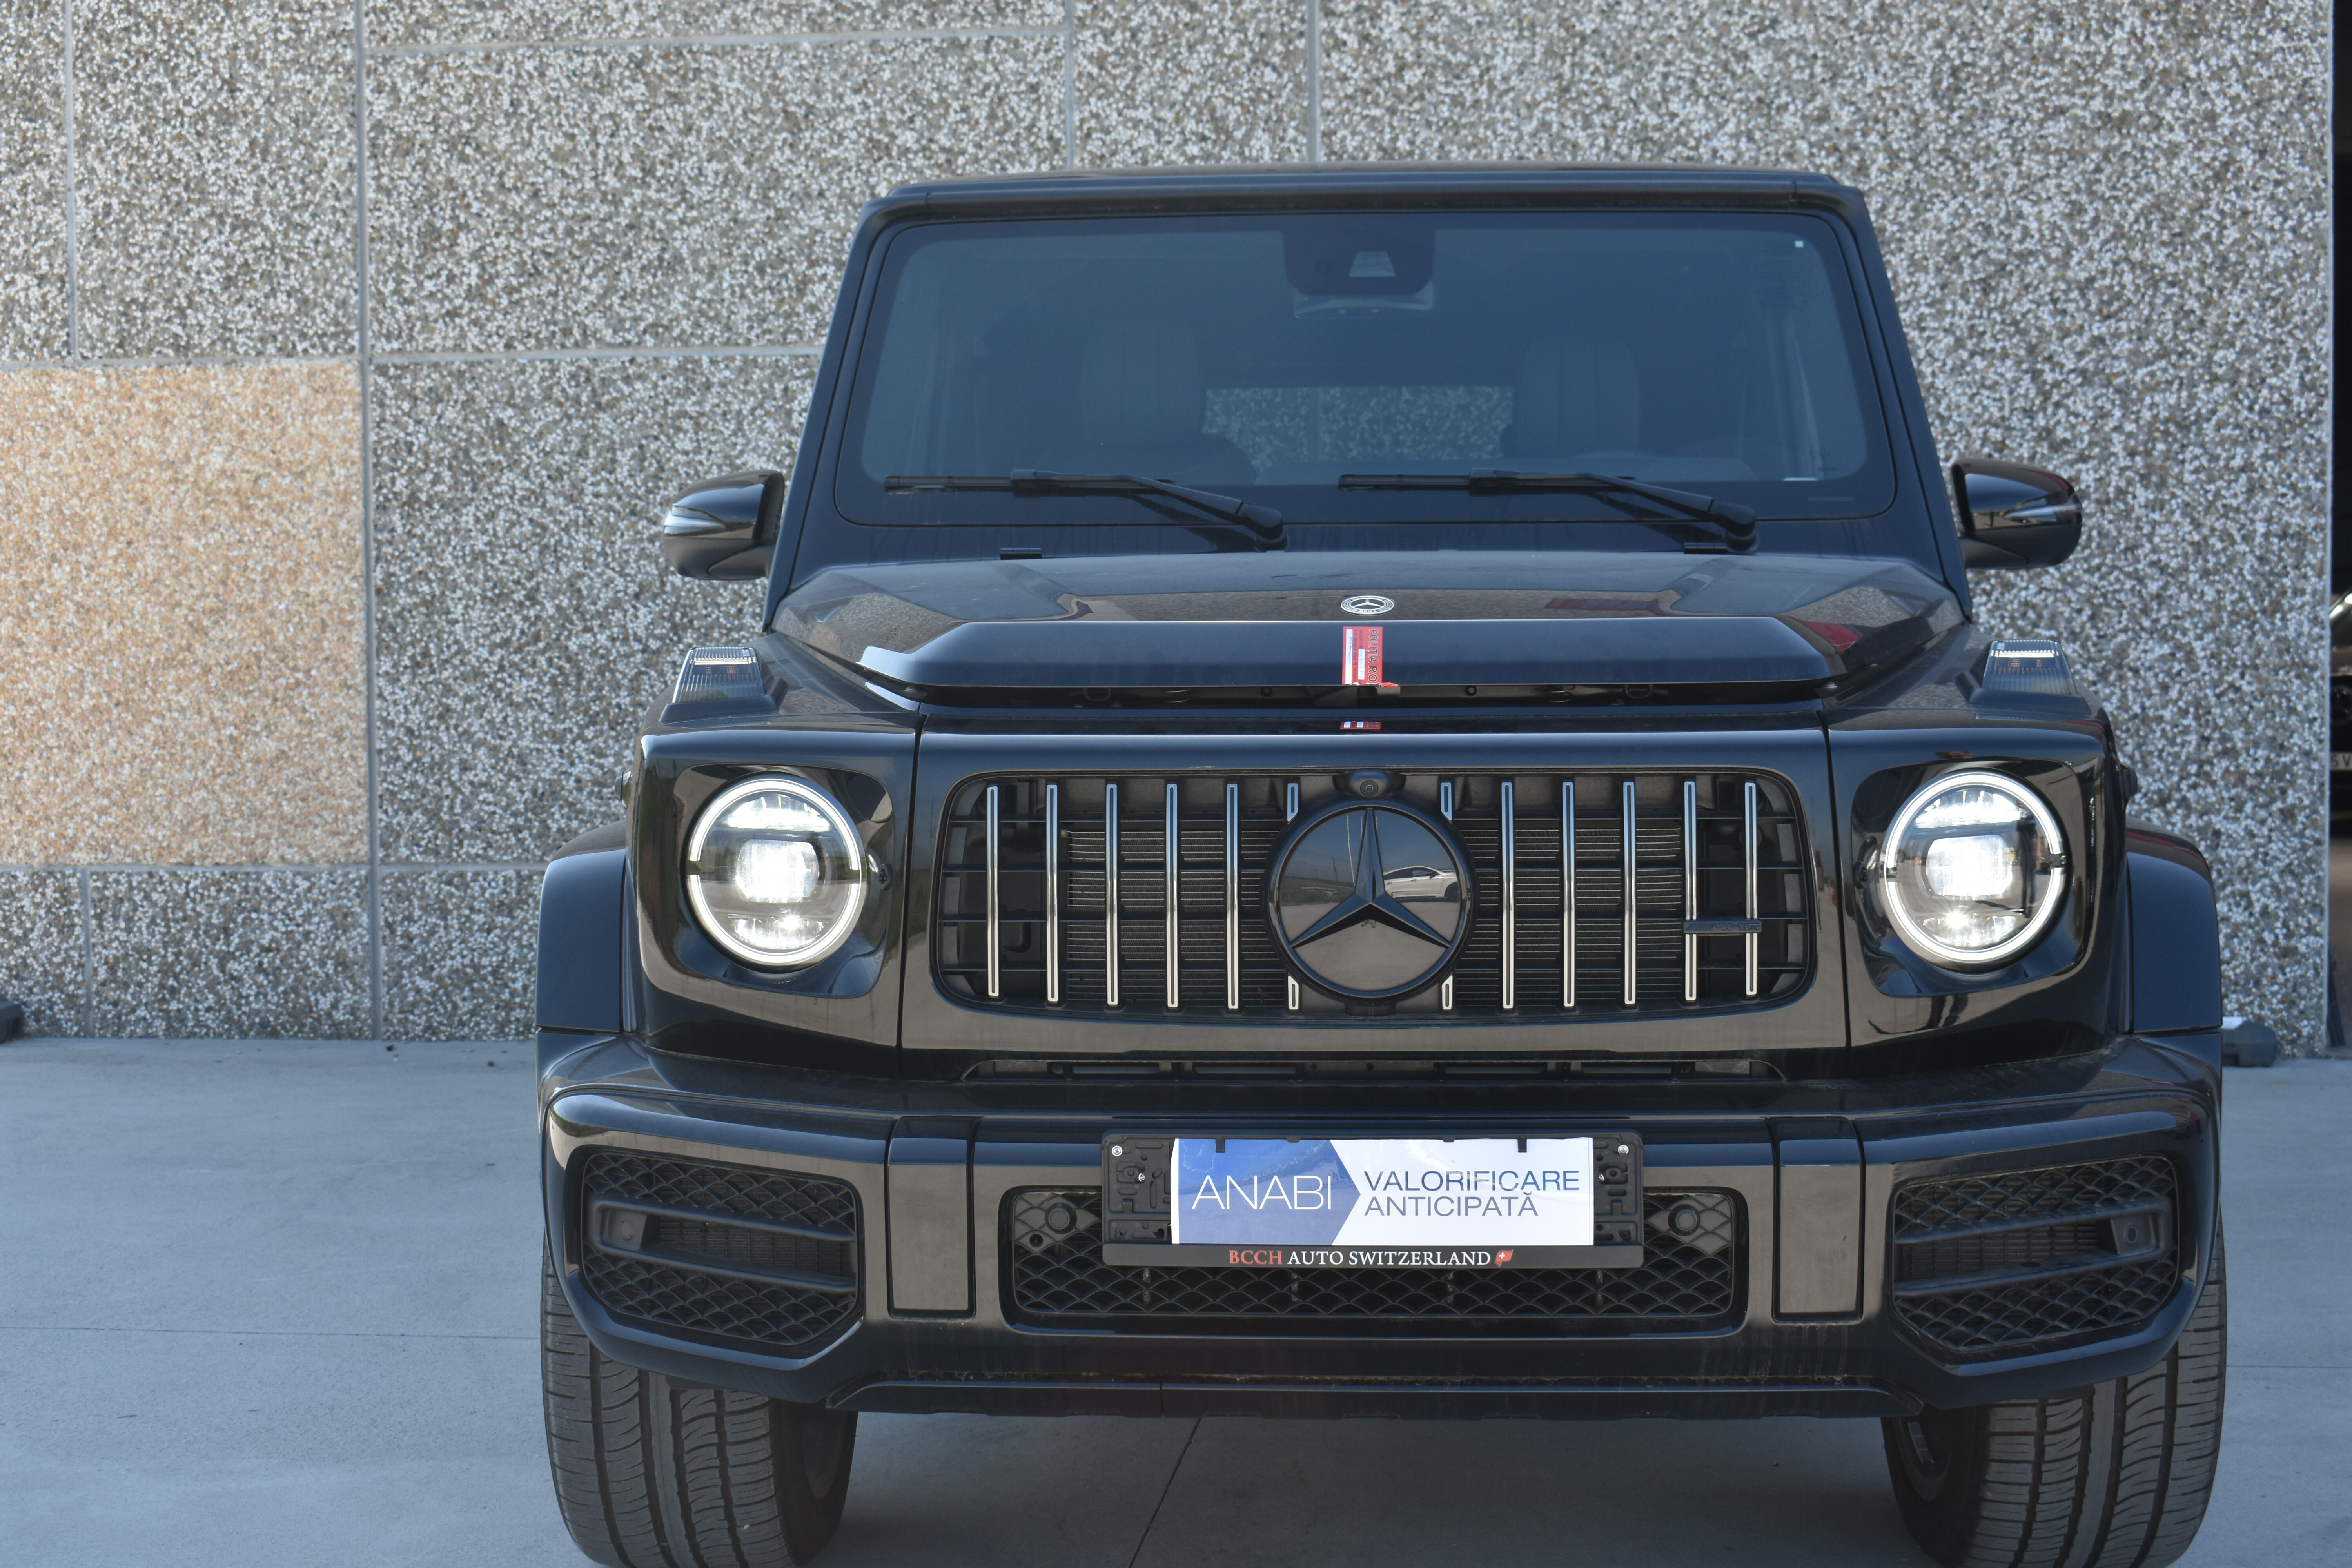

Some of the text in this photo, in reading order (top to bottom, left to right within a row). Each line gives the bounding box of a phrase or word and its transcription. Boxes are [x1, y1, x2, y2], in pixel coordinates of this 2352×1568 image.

[1710, 923, 1760, 931] AMG
[1364, 1170, 1580, 1191] VALORIFICARE
[1191, 1175, 1331, 1210] ANABI
[1364, 1191, 1539, 1217] ANTICIPATĂ
[1229, 1250, 1491, 1265] BCCH AUTO SWITZERLAND
